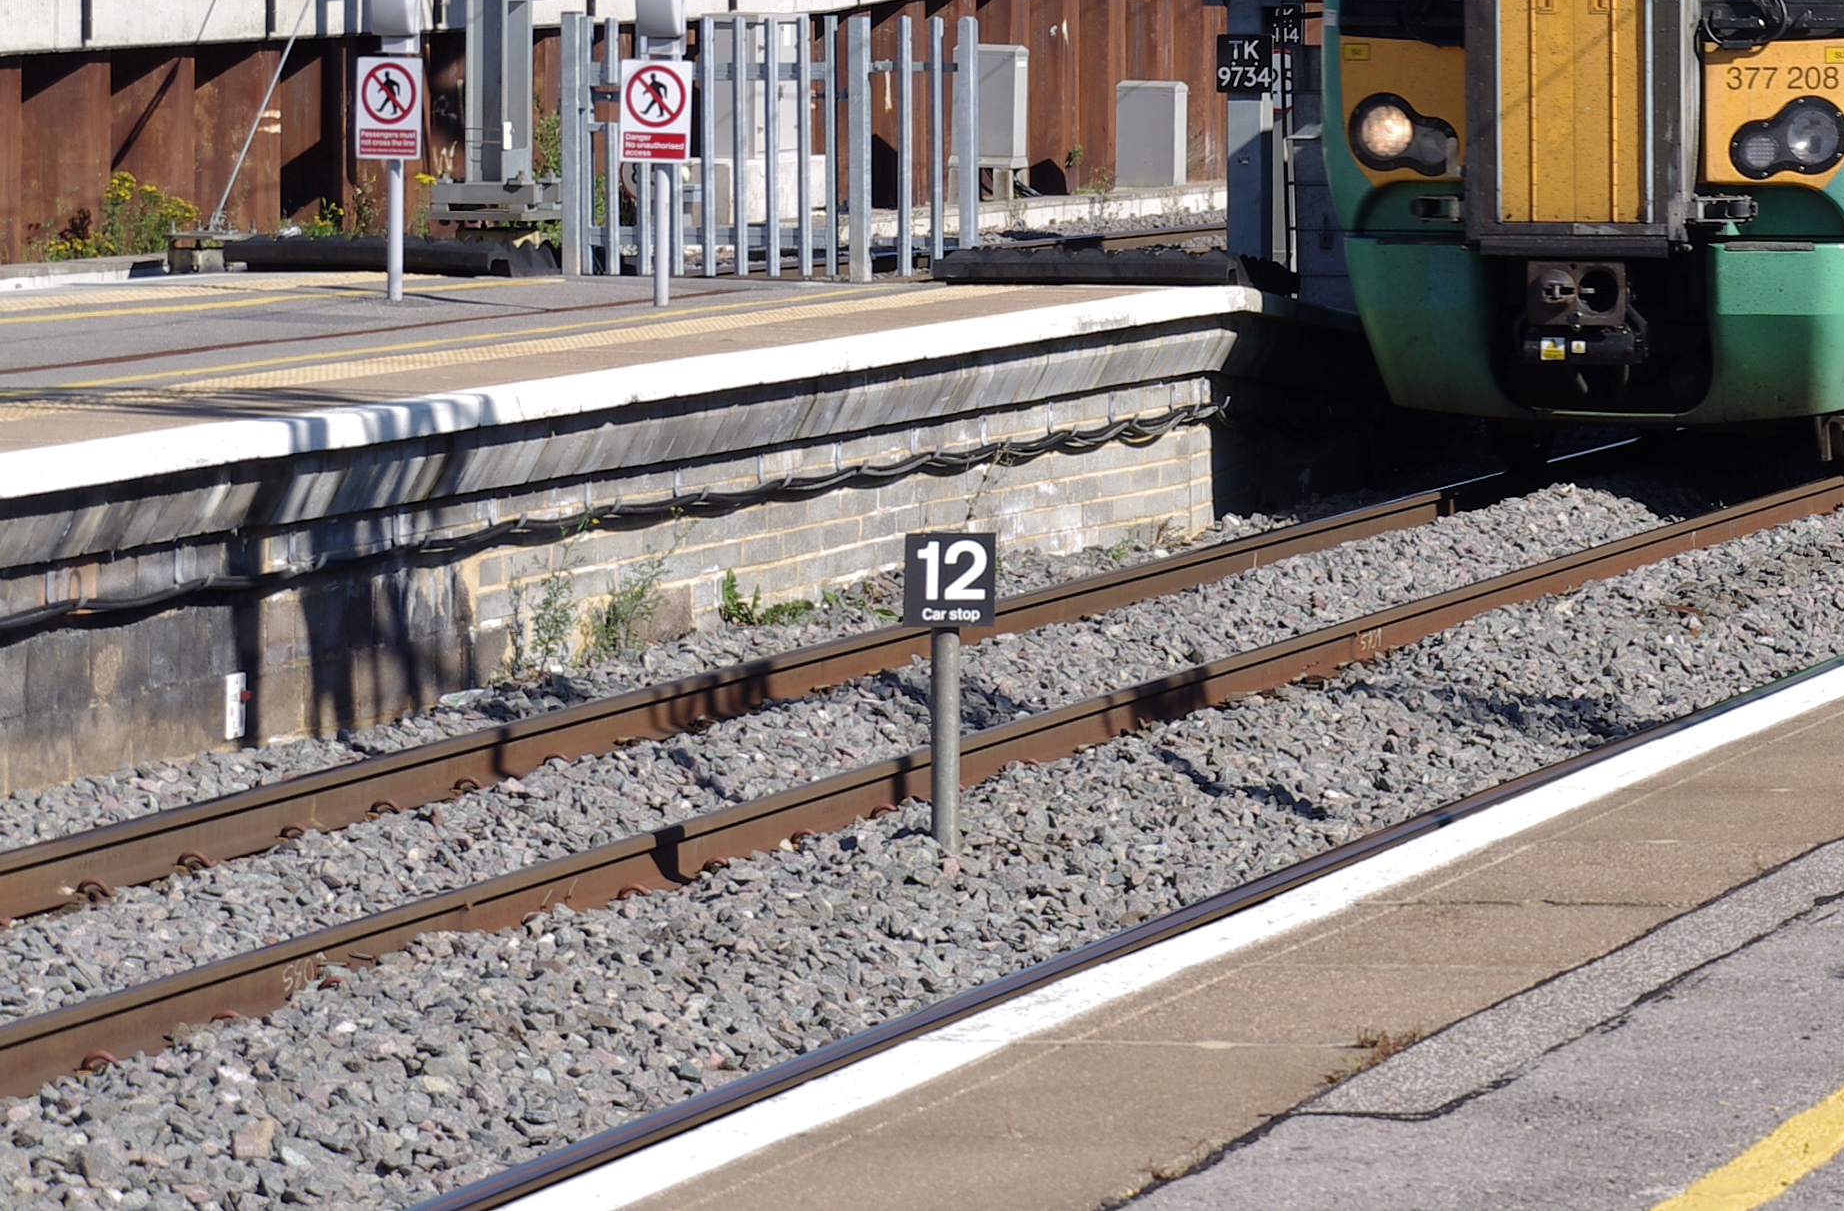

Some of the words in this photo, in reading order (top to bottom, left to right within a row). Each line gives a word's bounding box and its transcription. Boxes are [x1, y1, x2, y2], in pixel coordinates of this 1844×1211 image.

[1228, 40, 1260, 60] TK
[1217, 66, 1272, 88] 9734
[1726, 66, 1778, 90] 377
[1787, 66, 1839, 90] 208
[361, 130, 399, 139] Passengers
[625, 133, 652, 142] Danger
[637, 142, 685, 150] unauthorised
[917, 539, 988, 601] 12
[921, 607, 947, 621] Car
[948, 607, 981, 623] stop
